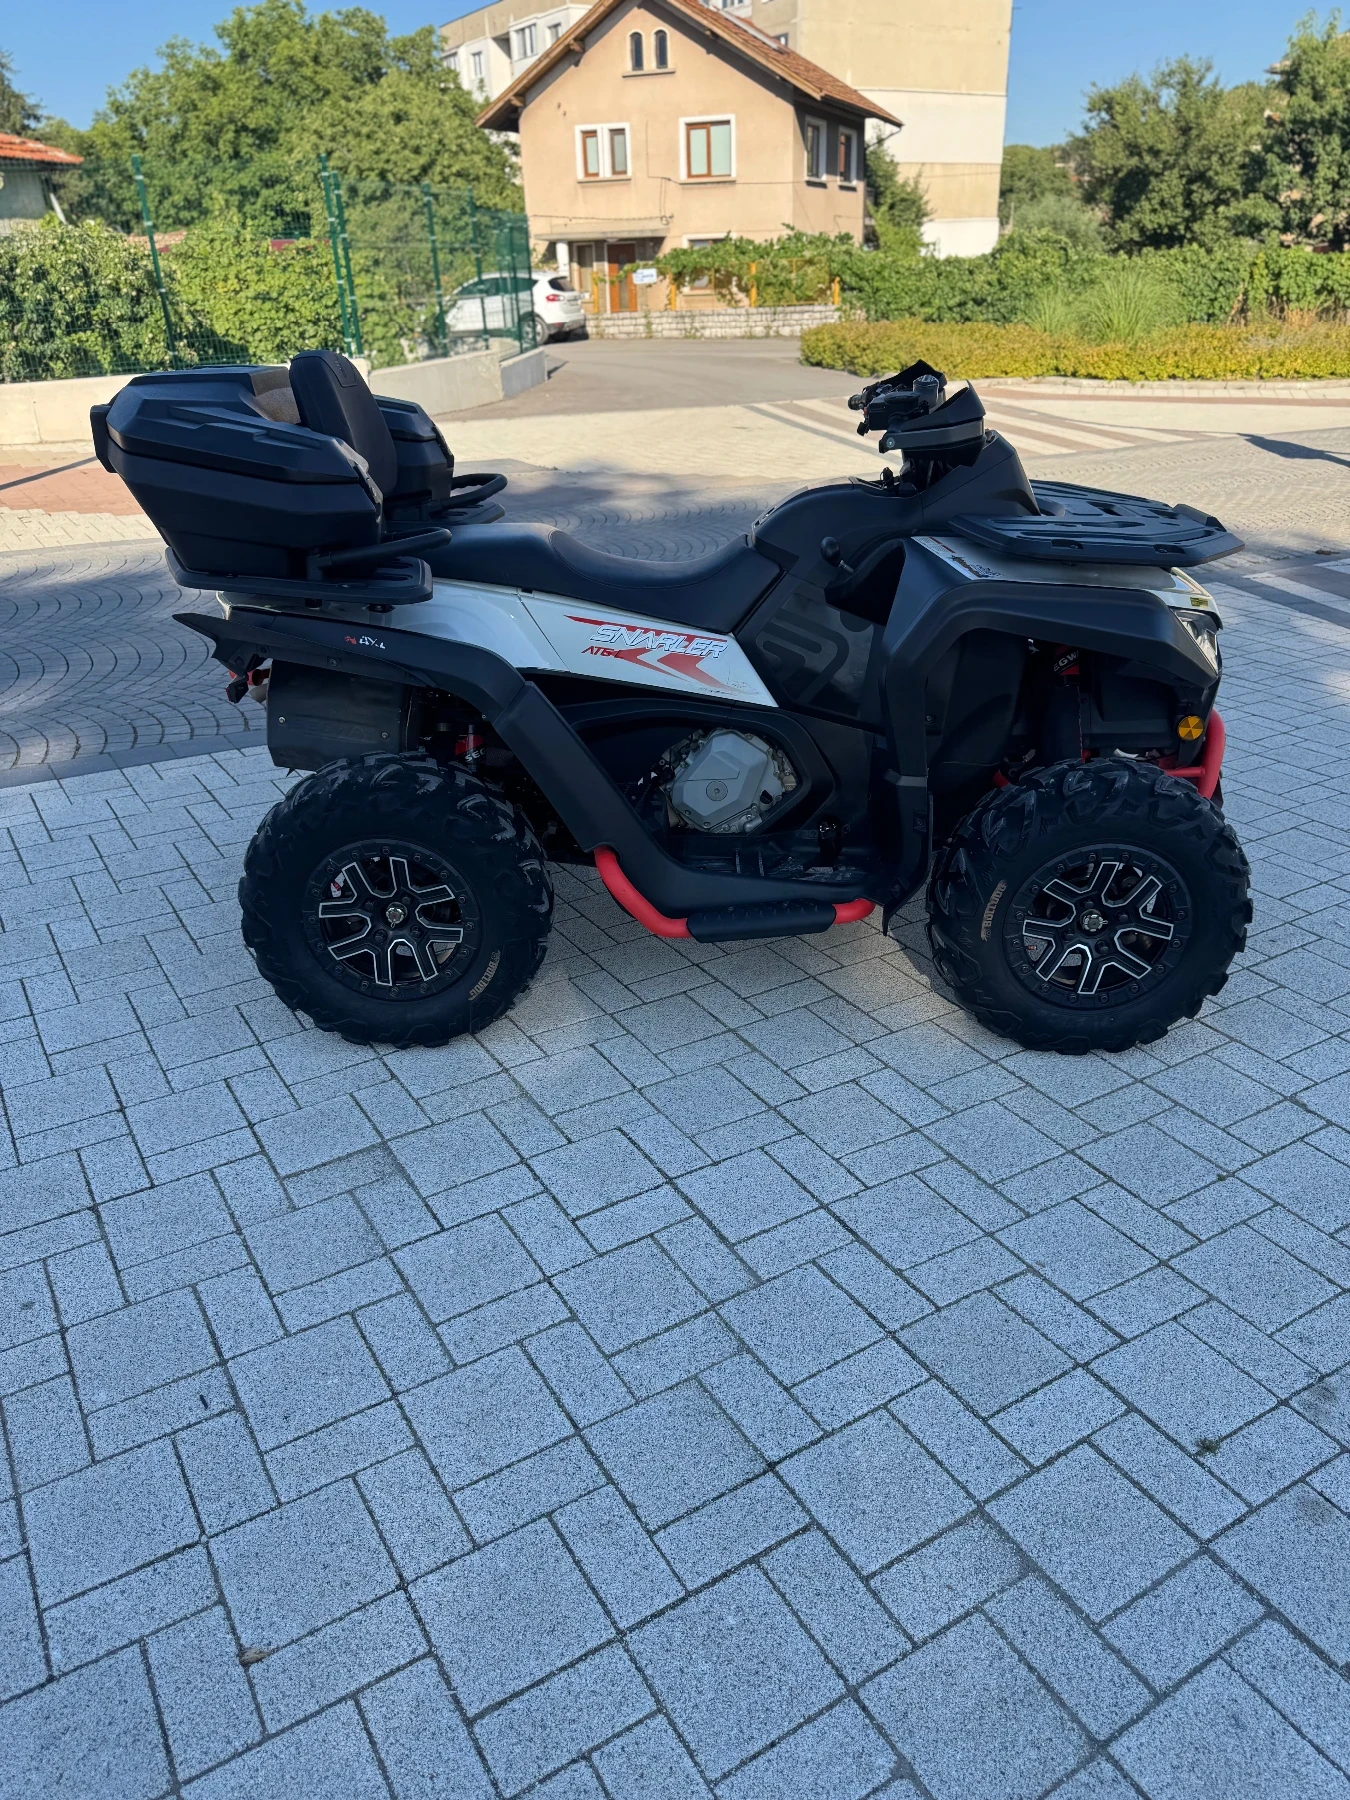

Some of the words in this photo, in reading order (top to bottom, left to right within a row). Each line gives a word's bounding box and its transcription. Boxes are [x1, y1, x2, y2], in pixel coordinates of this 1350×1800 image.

[589, 624, 729, 659] SNARLER
[981, 879, 1008, 927] BULLDOG
[468, 960, 499, 1001] BULLDOG
